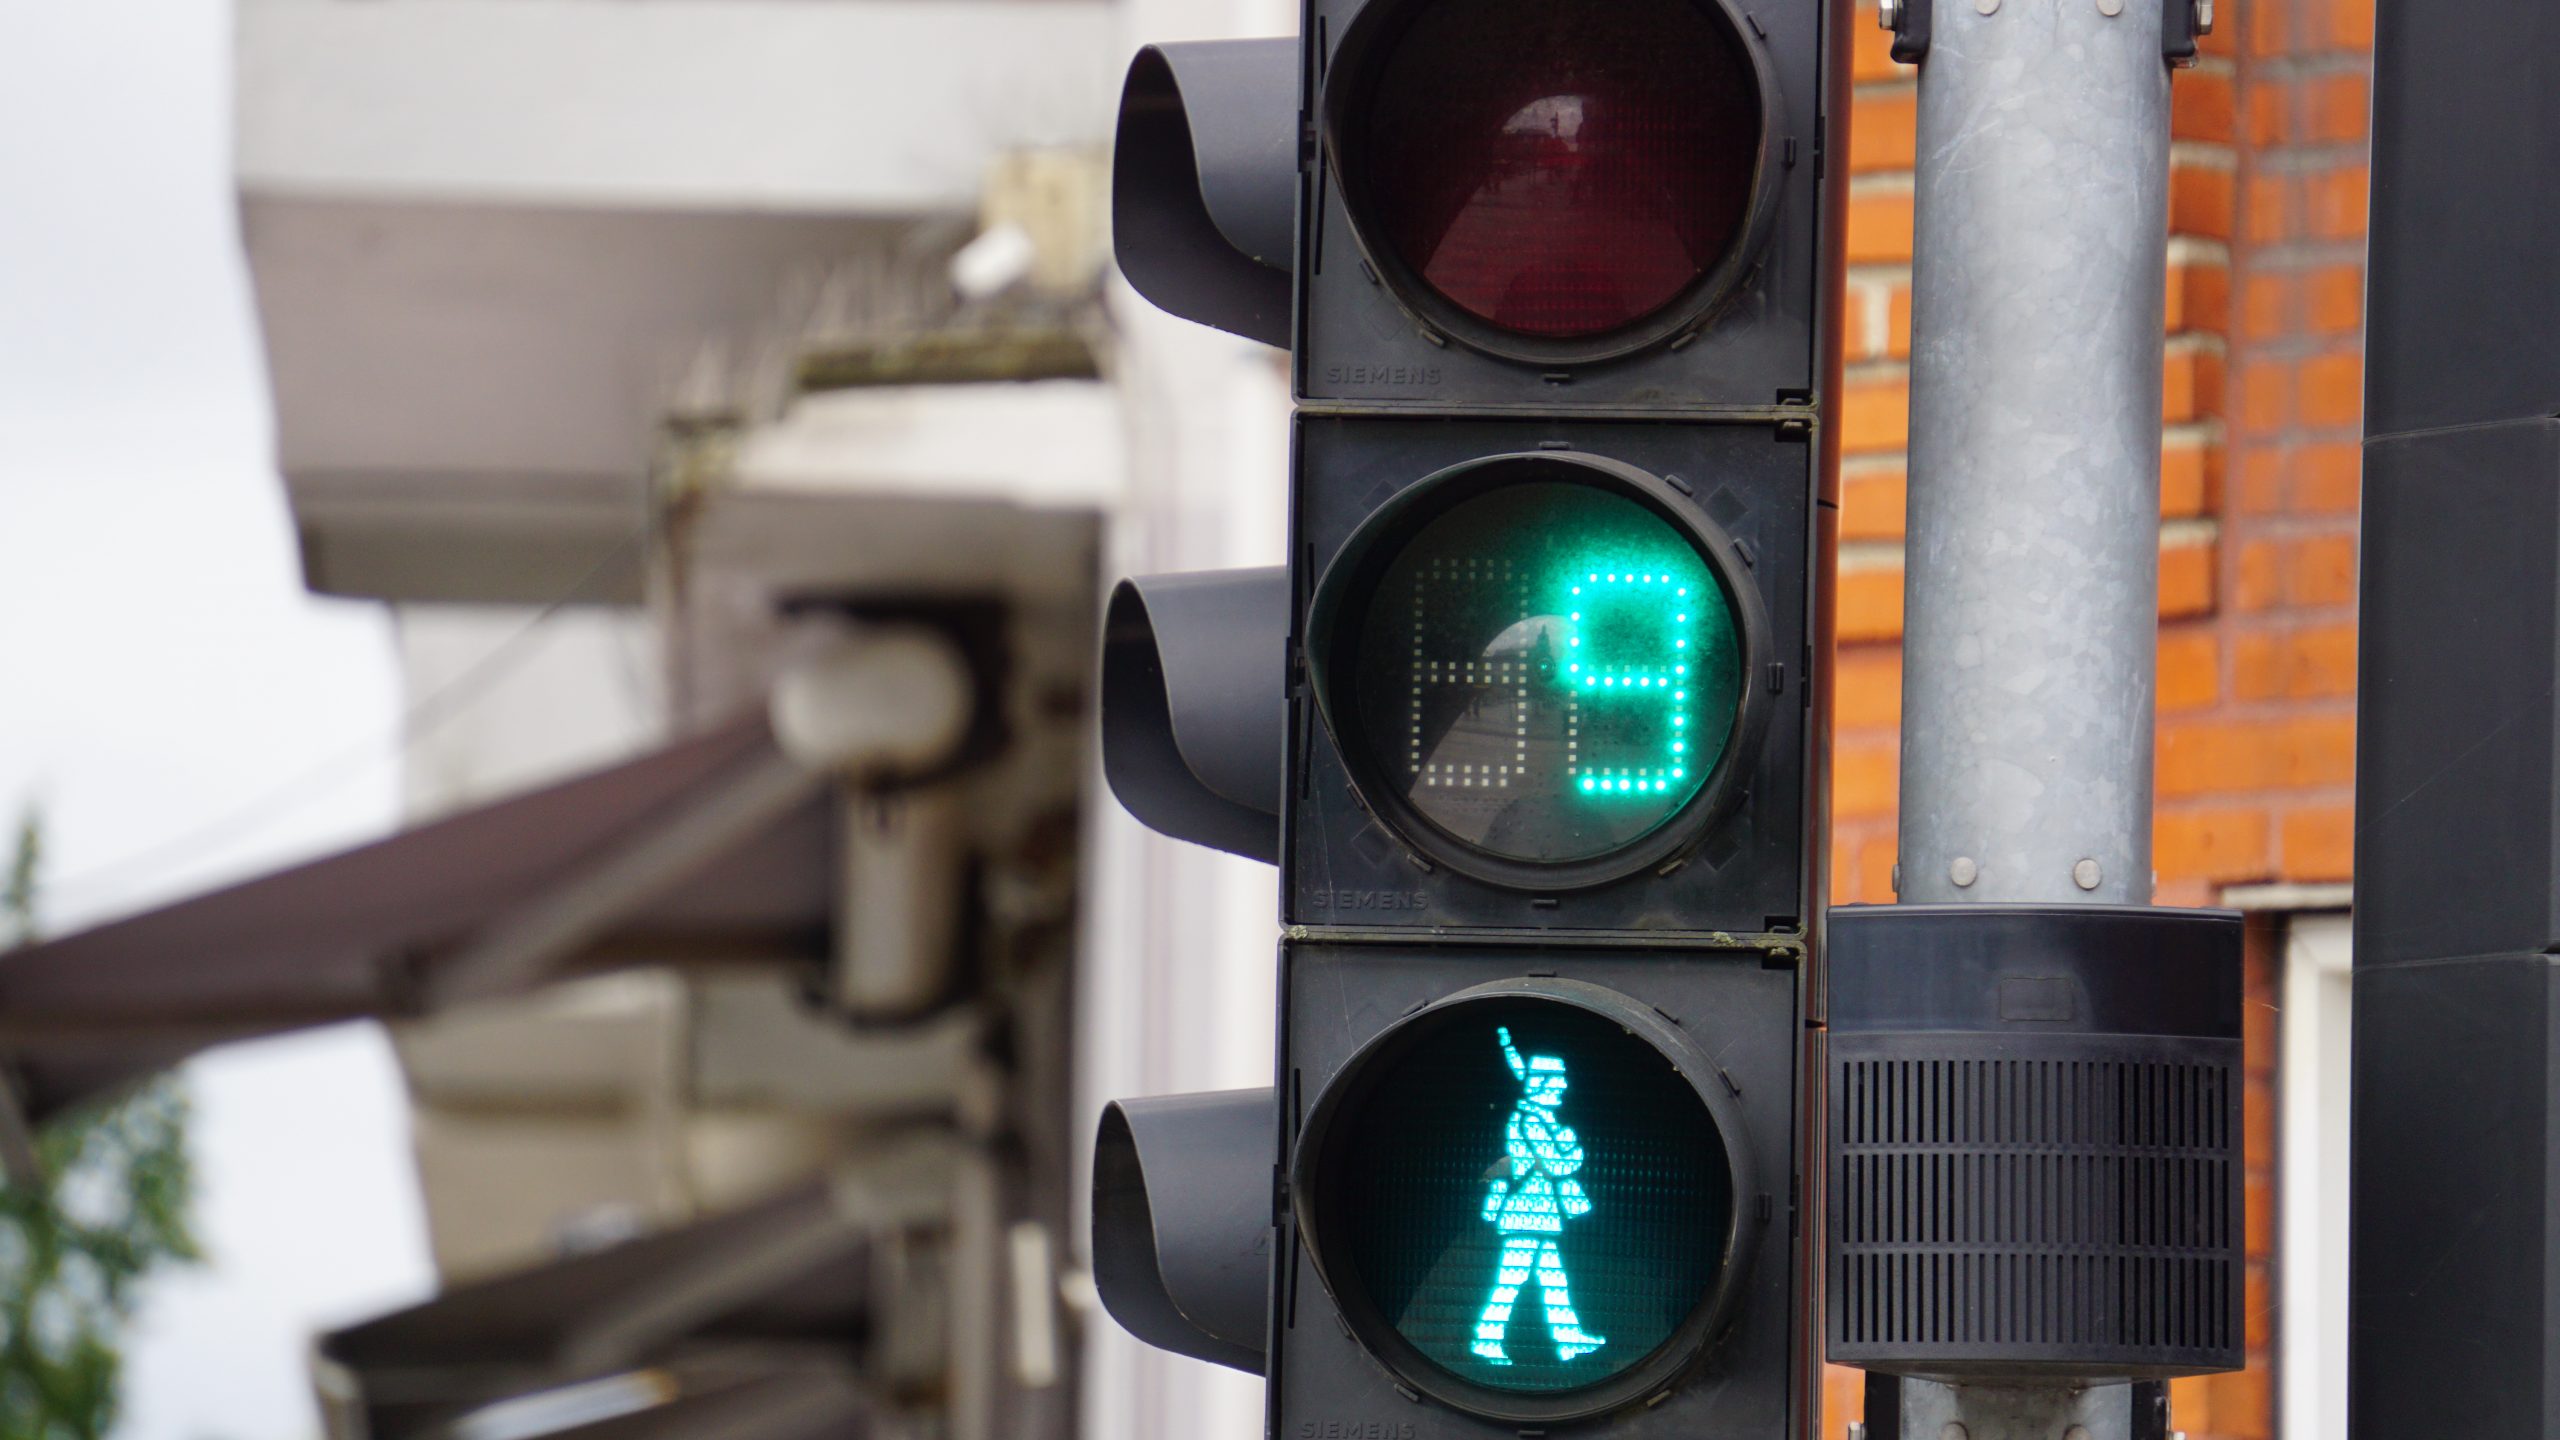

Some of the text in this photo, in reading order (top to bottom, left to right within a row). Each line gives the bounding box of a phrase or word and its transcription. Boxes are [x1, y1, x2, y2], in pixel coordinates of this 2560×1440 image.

[1327, 366, 1442, 386] SIEMENS
[1567, 571, 1689, 793] 9
[1313, 889, 1428, 911] SIEMENS
[1302, 1421, 1416, 1440] SIEMENS
